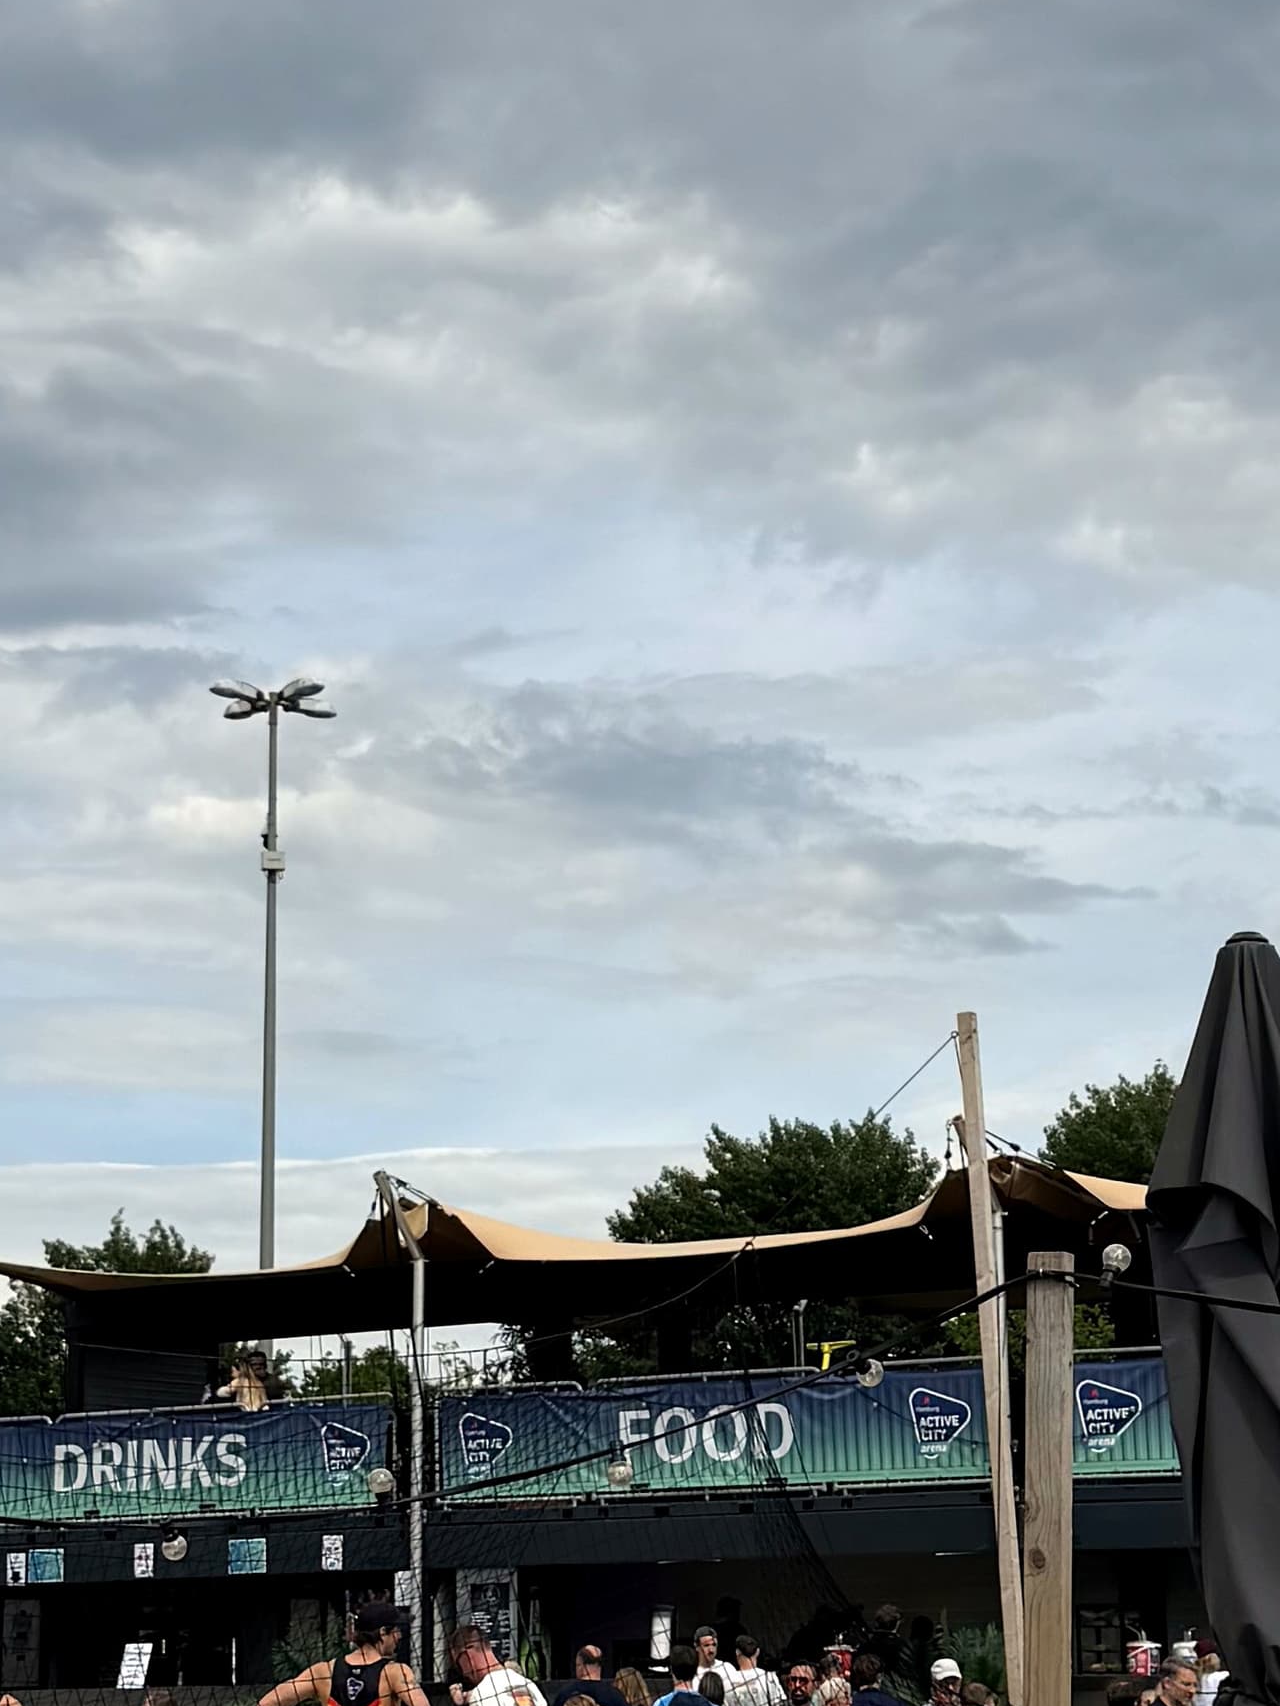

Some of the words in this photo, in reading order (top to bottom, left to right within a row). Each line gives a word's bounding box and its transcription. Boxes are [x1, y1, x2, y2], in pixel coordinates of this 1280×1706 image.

[920, 1414, 960, 1427] ACTIVE
[1086, 1407, 1129, 1421] ACTIVE
[619, 1403, 794, 1465] FOOD
[1088, 1422, 1115, 1434] CITY
[921, 1429, 947, 1441] CITY
[54, 1434, 247, 1493] DRINKS
